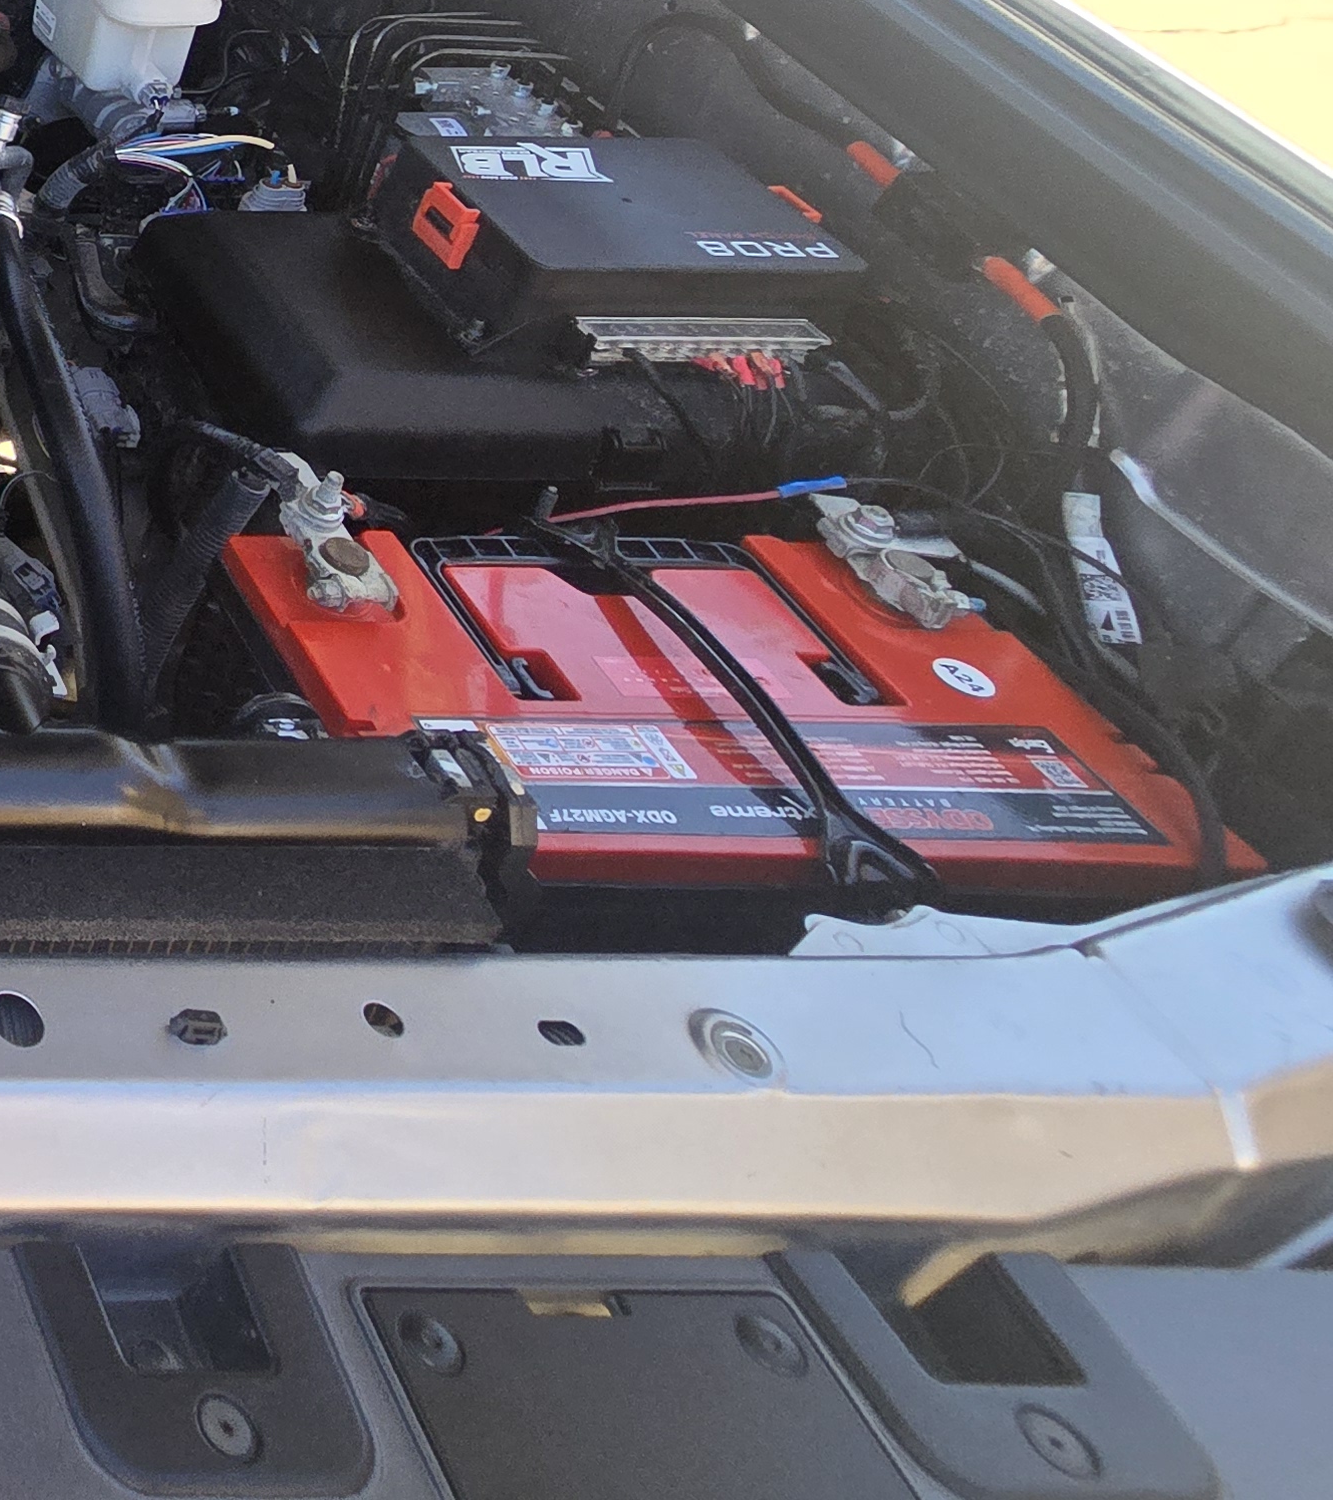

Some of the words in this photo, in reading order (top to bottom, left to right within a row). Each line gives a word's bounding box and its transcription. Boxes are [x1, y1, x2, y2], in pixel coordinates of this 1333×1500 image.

[457, 142, 603, 180] RLB
[695, 240, 840, 259] PRO8
[938, 663, 985, 694] A24
[548, 806, 678, 824] ODX-AGM27F
[710, 794, 819, 822] xtreme
[857, 797, 952, 808] BATTERY
[863, 806, 994, 831] ODYSSE
